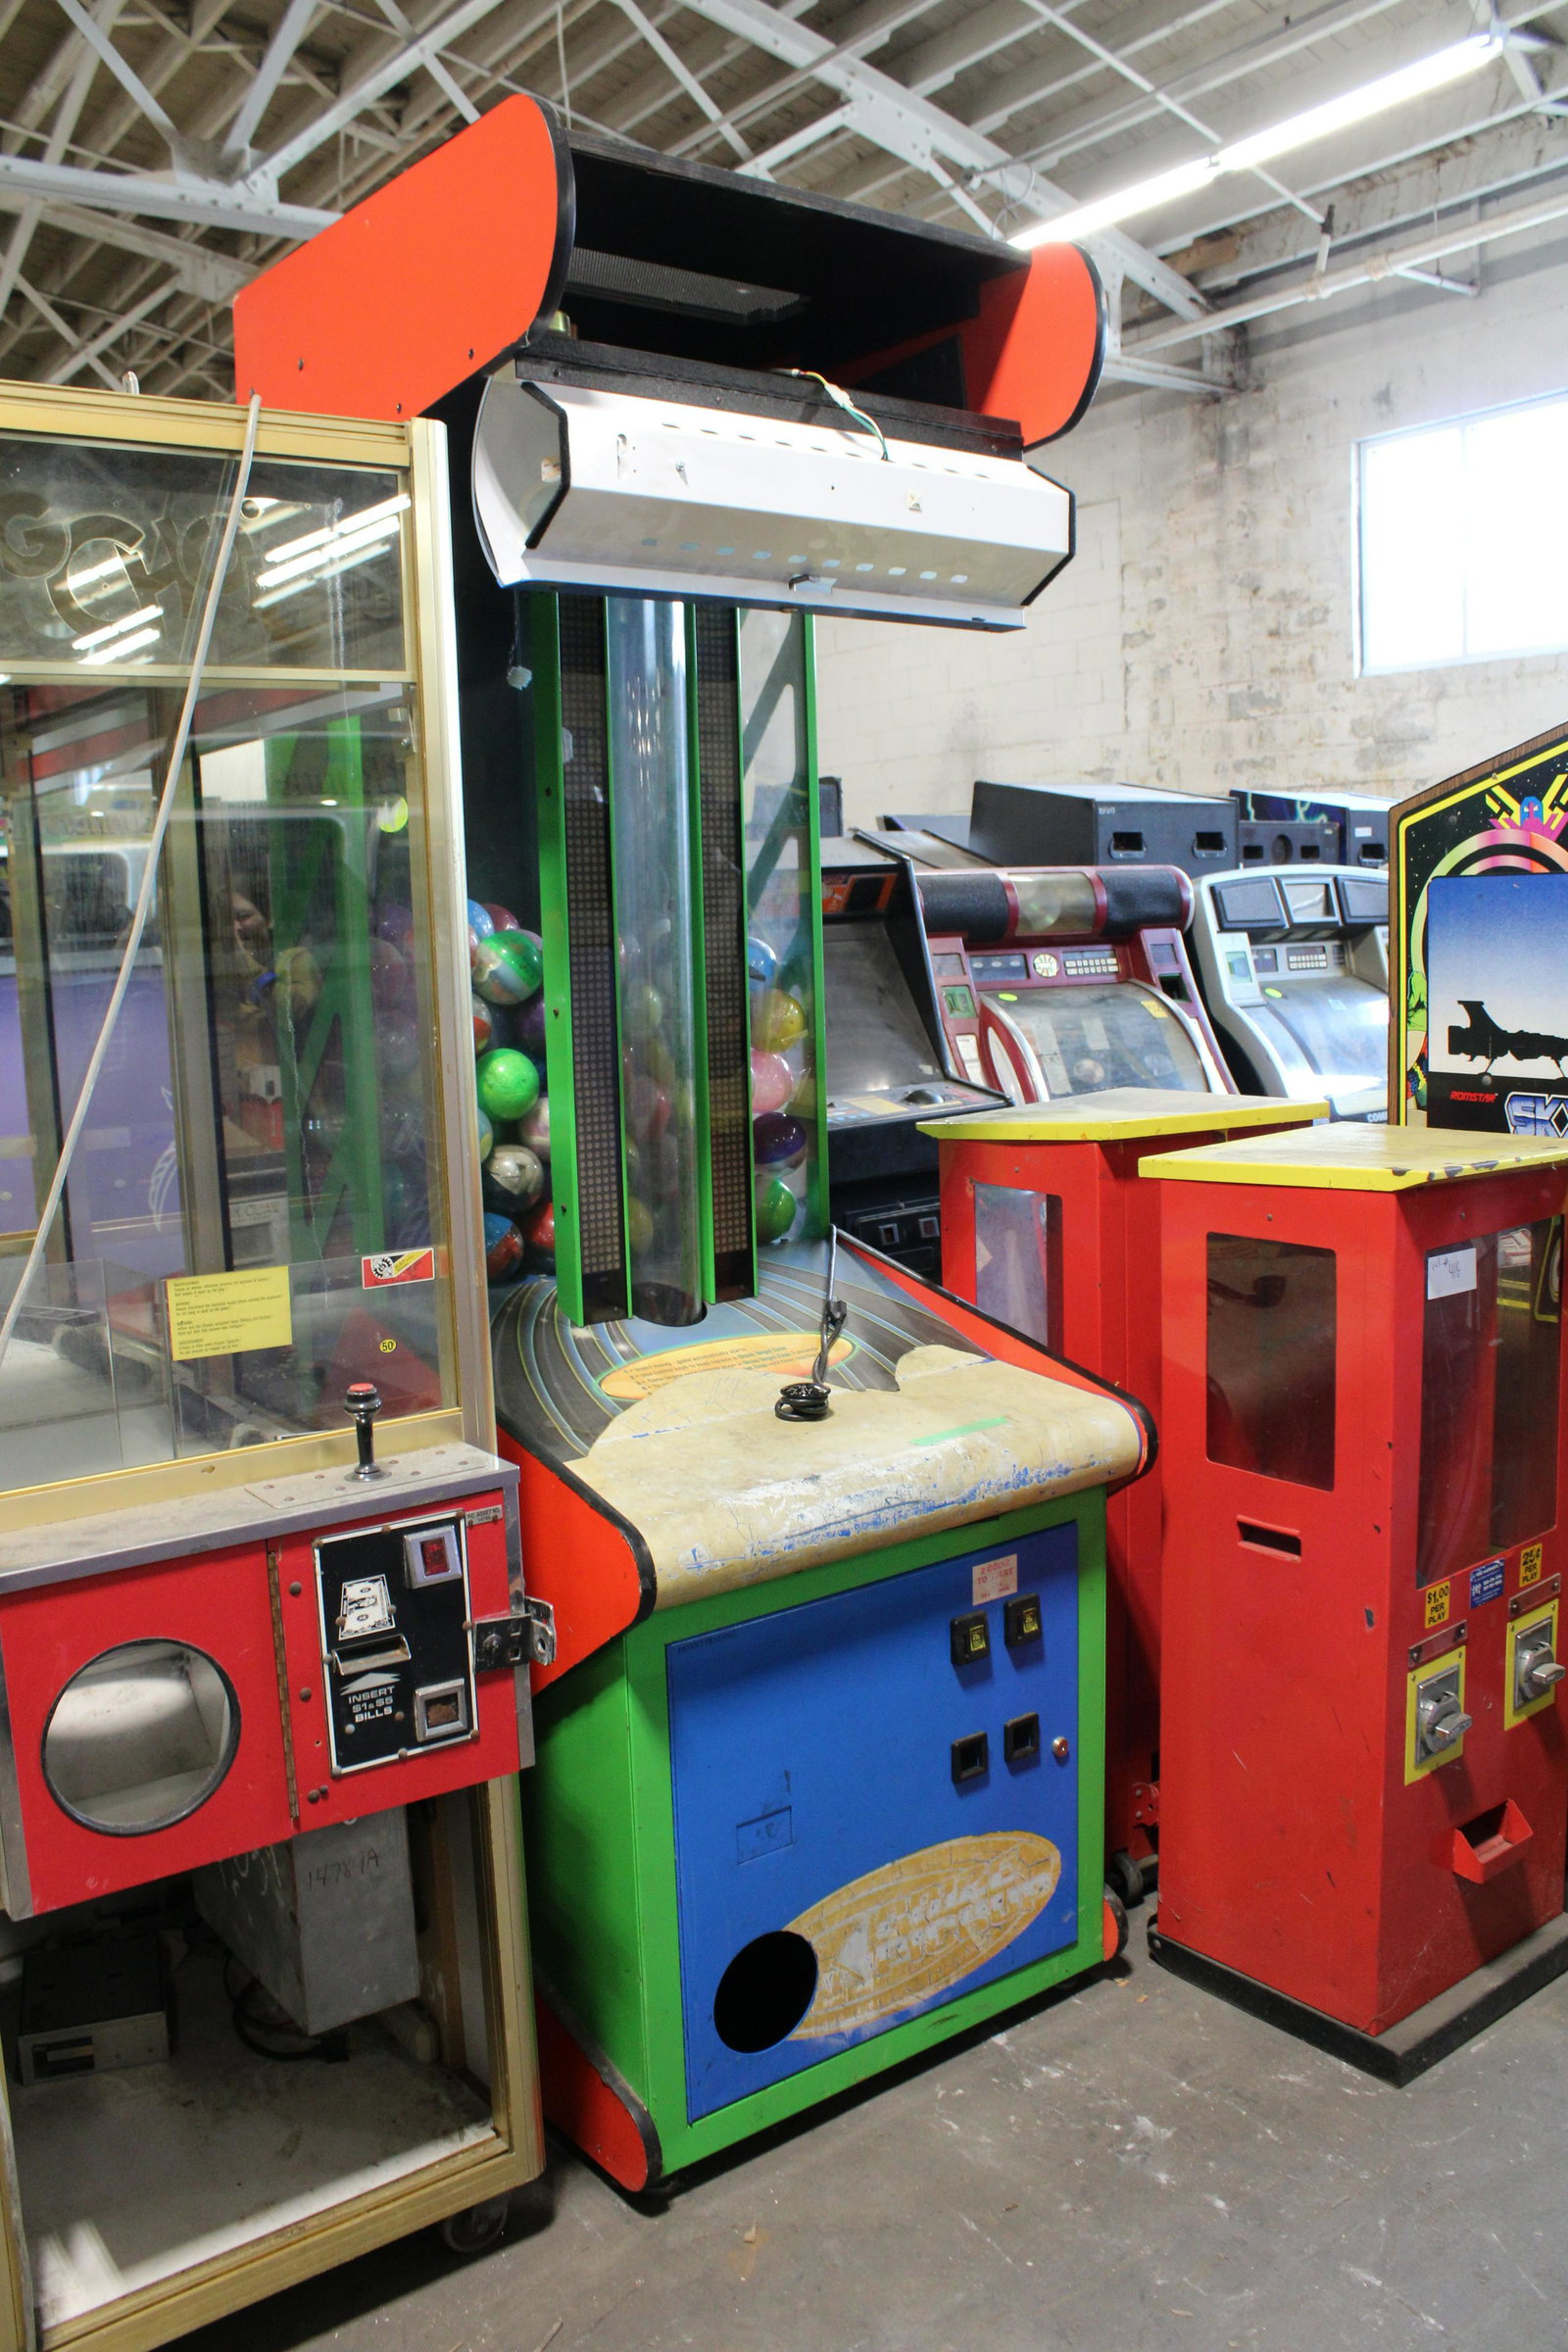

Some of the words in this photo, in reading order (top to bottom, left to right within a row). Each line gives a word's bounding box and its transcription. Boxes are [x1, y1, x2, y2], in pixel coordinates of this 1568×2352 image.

[1450, 1091, 1496, 1103] ROMSTAR
[1508, 1094, 1568, 1138] SK
[1525, 1562, 1538, 1574] PER
[1522, 1573, 1538, 1584] PLAY
[1427, 1585, 1449, 1604] $1.00
[1430, 1602, 1445, 1615] PER
[1428, 1612, 1446, 1625] PLAY
[348, 1686, 395, 1705] INSERT
[355, 1705, 393, 1724] BILLS
